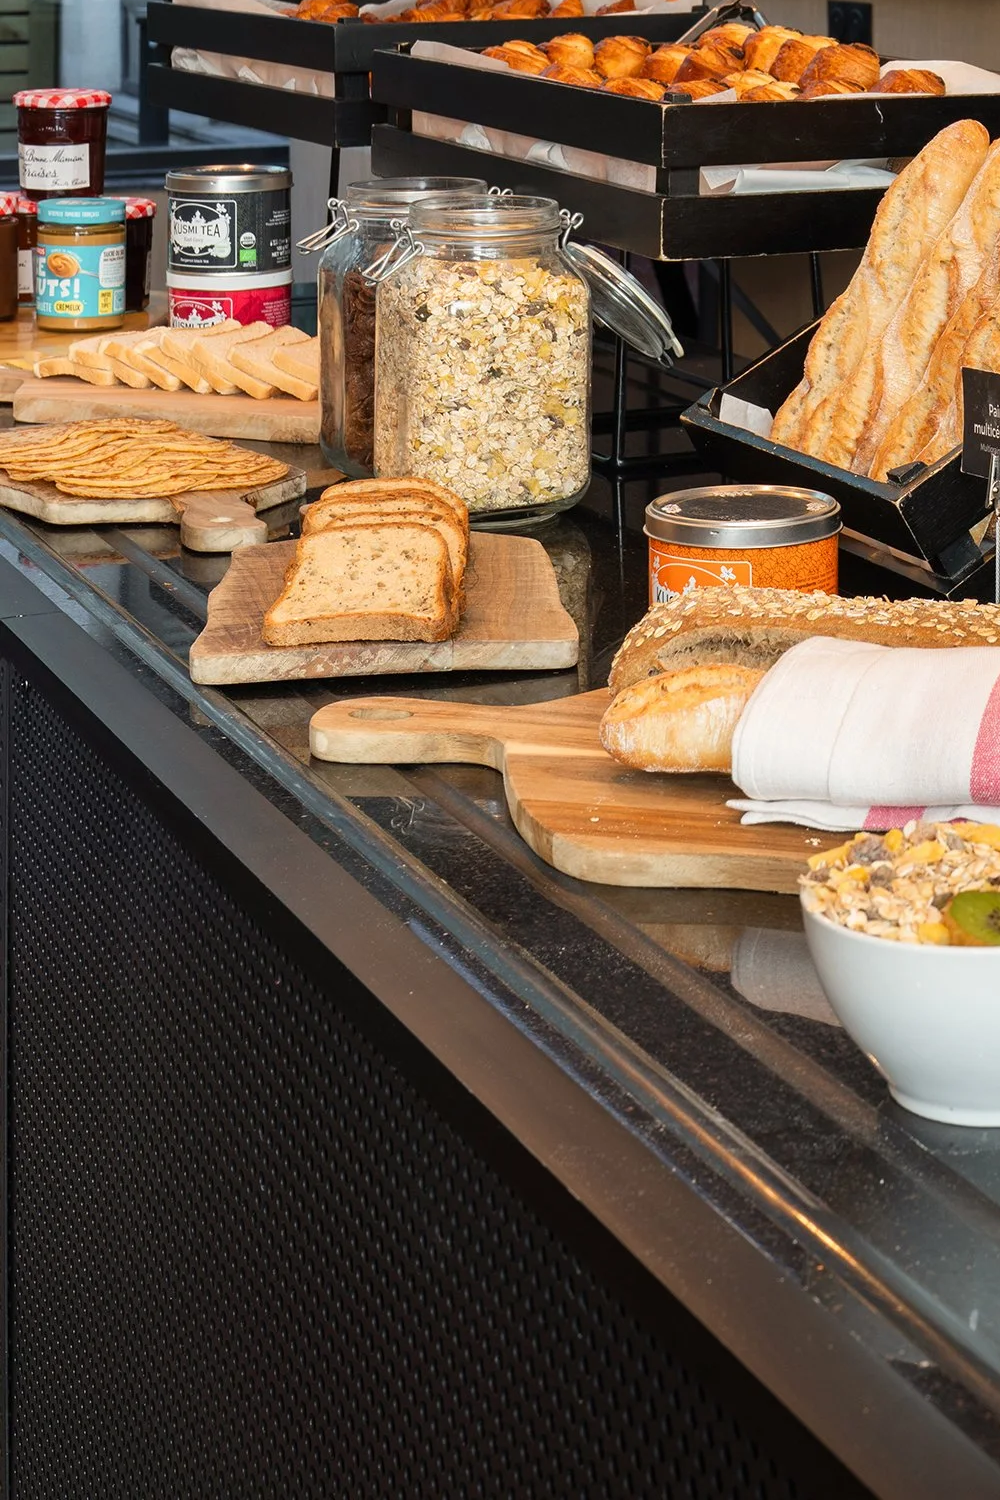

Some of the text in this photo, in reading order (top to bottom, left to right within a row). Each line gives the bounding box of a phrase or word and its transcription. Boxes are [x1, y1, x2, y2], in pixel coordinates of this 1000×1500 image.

[173, 222, 221, 238] KUSMI TEA
[37, 277, 80, 299] UTS!
